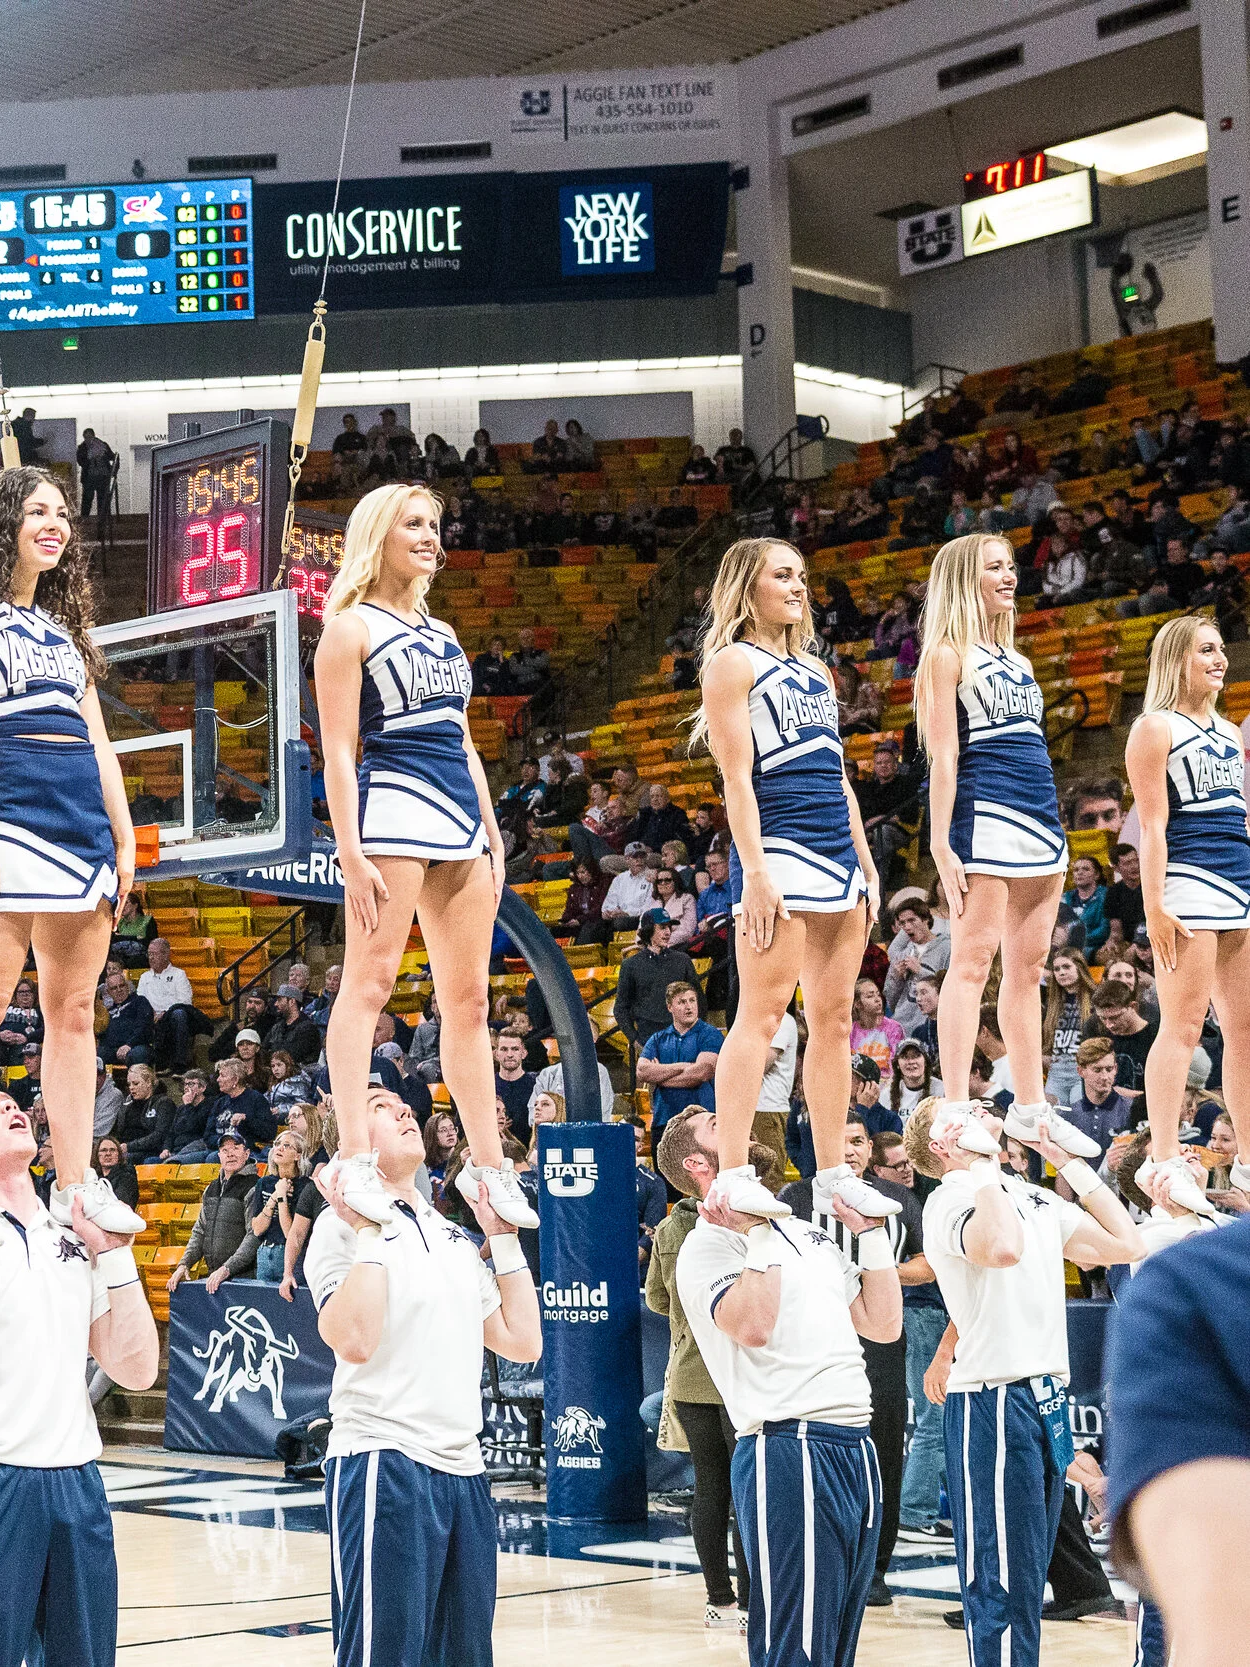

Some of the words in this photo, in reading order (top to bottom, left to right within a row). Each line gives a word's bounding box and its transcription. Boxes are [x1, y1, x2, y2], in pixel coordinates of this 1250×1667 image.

[573, 88, 615, 102] AGGIE
[619, 86, 647, 100] FAN
[650, 83, 681, 99] TEXT
[685, 81, 714, 97] LINE
[595, 101, 694, 118] 435-554-1010
[30, 193, 106, 229] 15:45
[230, 204, 242, 219] 0
[574, 191, 641, 219] NEW
[1222, 195, 1241, 223] E
[233, 227, 241, 242] 1
[286, 206, 462, 260] CONSERVICE
[564, 212, 649, 242] YORK
[89, 236, 98, 249] 1
[134, 233, 151, 257] 0
[905, 224, 956, 252] STATE
[233, 250, 241, 264] 1
[576, 238, 641, 265] LIFE
[42, 271, 51, 284] 4
[90, 269, 100, 282] 4
[289, 263, 320, 276] utility
[323, 259, 407, 275] management
[410, 258, 420, 270] &
[423, 257, 461, 271] billing
[152, 281, 162, 294] 3
[180, 274, 198, 289] 12
[232, 272, 243, 287] 0
[179, 296, 198, 312] 32
[234, 295, 243, 309] 1
[750, 323, 766, 346] D
[144, 433, 167, 442] WOM
[186, 457, 259, 516] 15:45
[289, 526, 345, 568] 5:45
[182, 512, 248, 605] 25
[1197, 749, 1245, 793] AGGIE
[246, 848, 346, 887] AMERI
[1053, 1029, 1082, 1048] RUE
[544, 1163, 599, 1181] STATE
[724, 1272, 742, 1283] STAT
[542, 1281, 609, 1308] Guild
[544, 1308, 609, 1323] mortgage
[1038, 1391, 1066, 1416] AGGS
[556, 1455, 601, 1469] AGGIES
